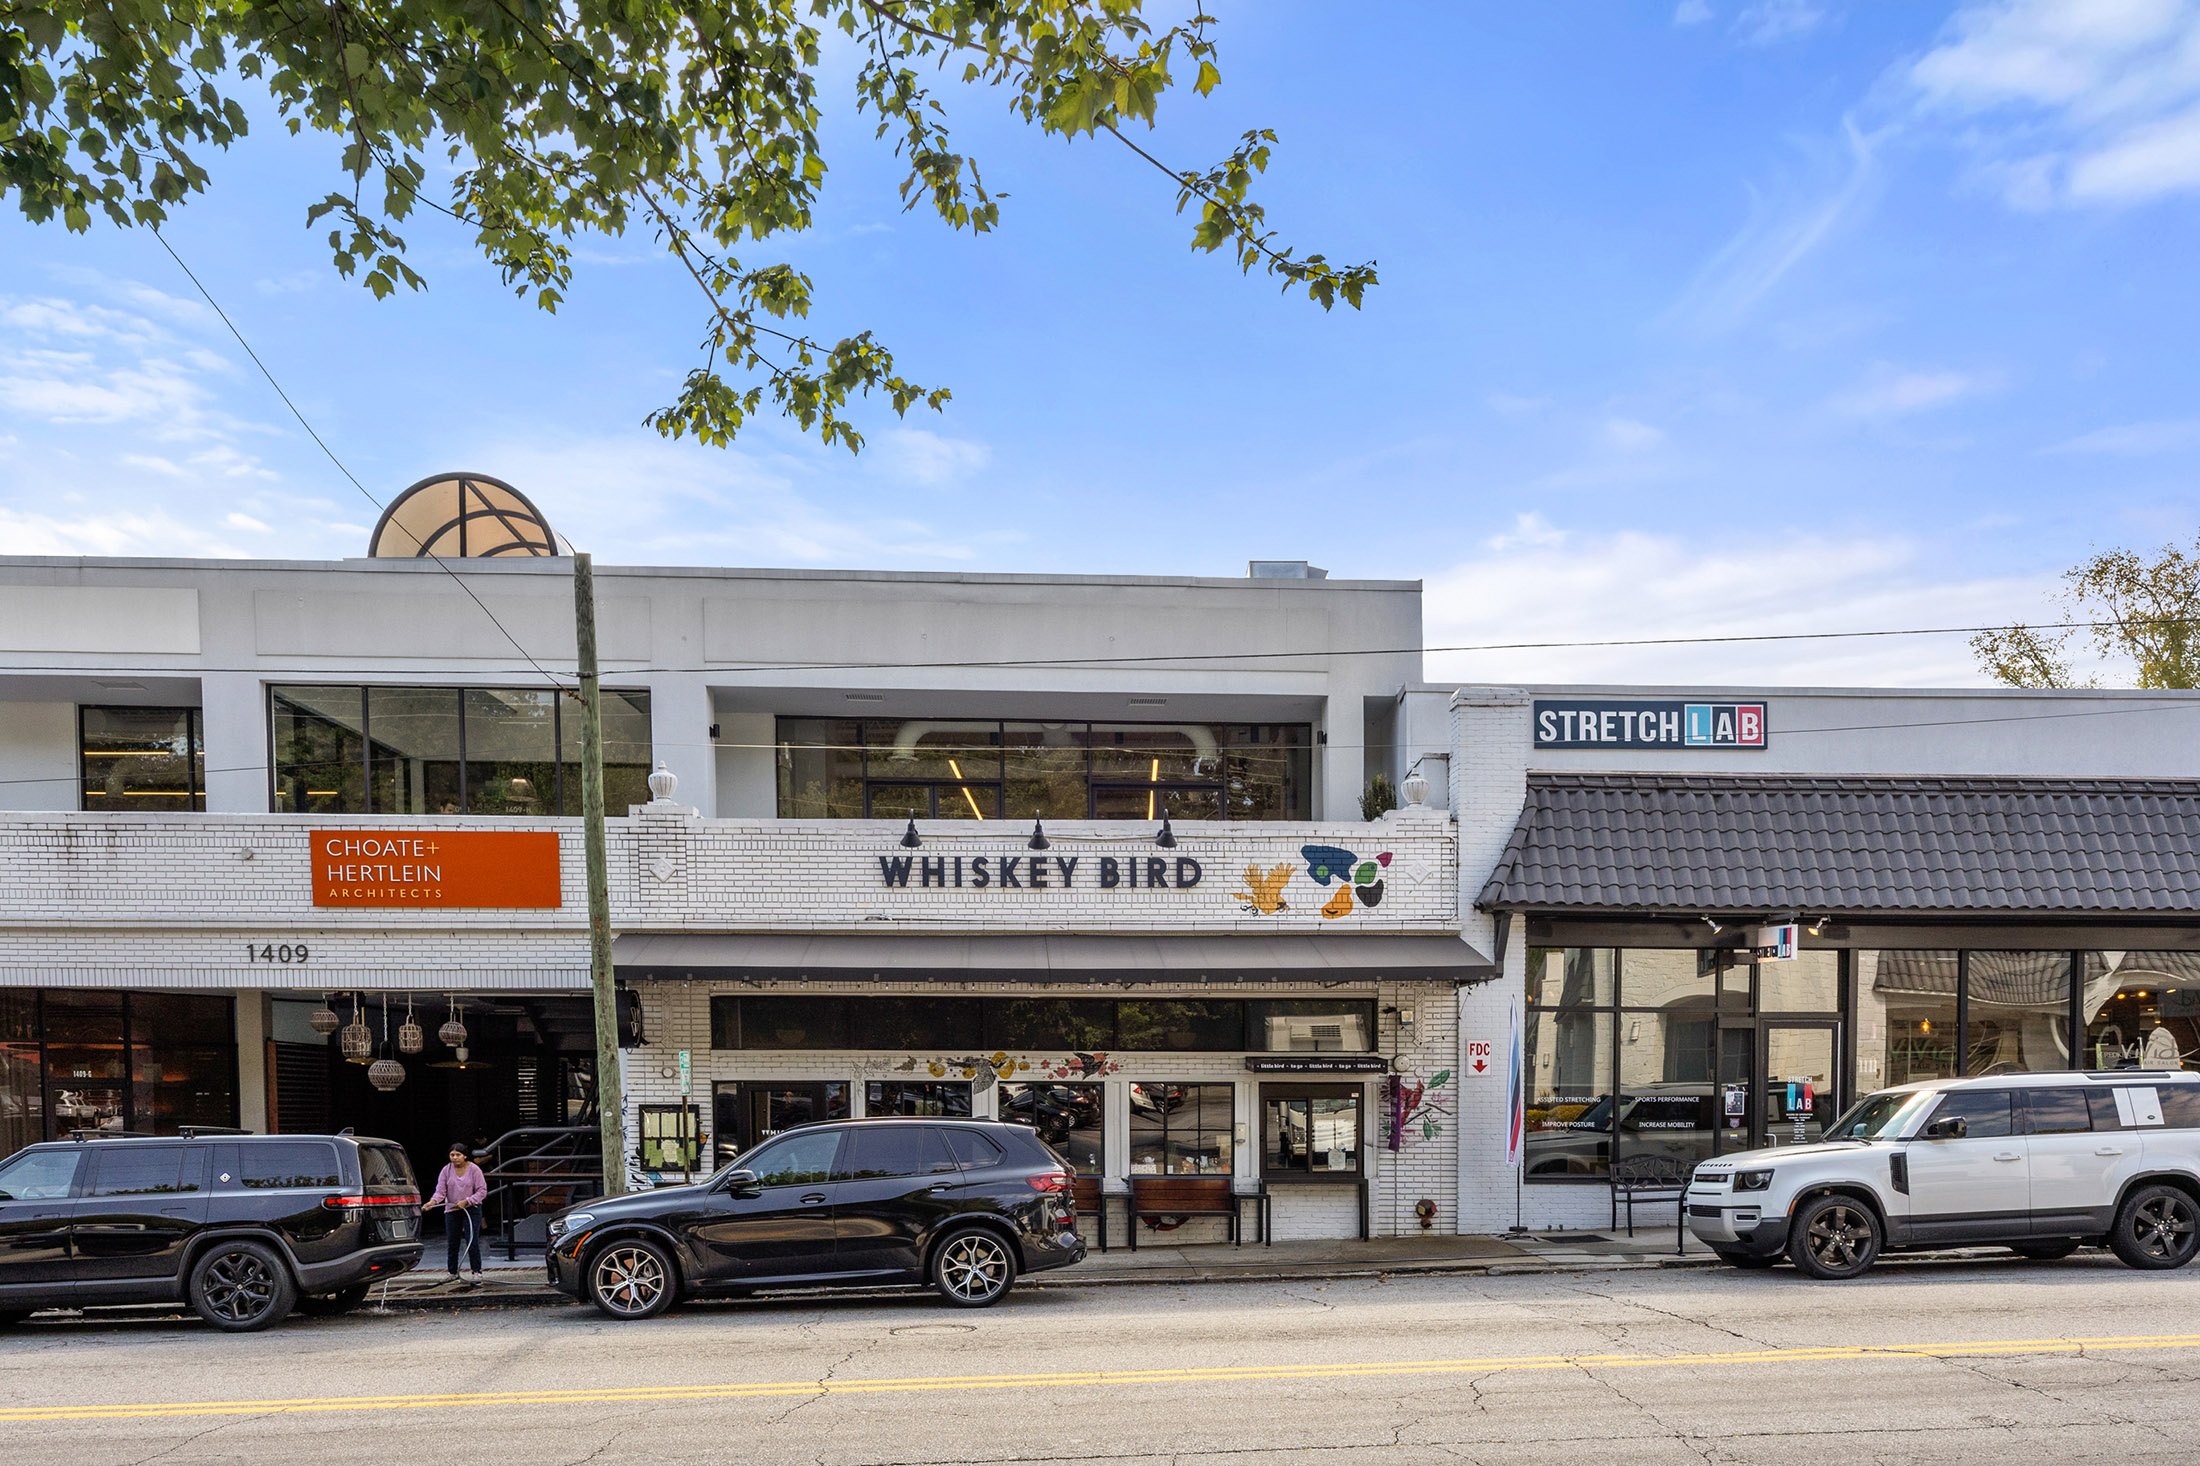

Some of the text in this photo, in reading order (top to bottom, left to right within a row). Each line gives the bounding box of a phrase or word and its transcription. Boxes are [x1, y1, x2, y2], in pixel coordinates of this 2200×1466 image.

[328, 865, 441, 882] HERTLEIN
[879, 856, 1202, 888] WHISKEY BIRD
[329, 888, 442, 898] ARCHITECTS
[246, 944, 309, 963] 1409
[1469, 1043, 1490, 1056] FDC
[1788, 1098, 1812, 1110] LAB
